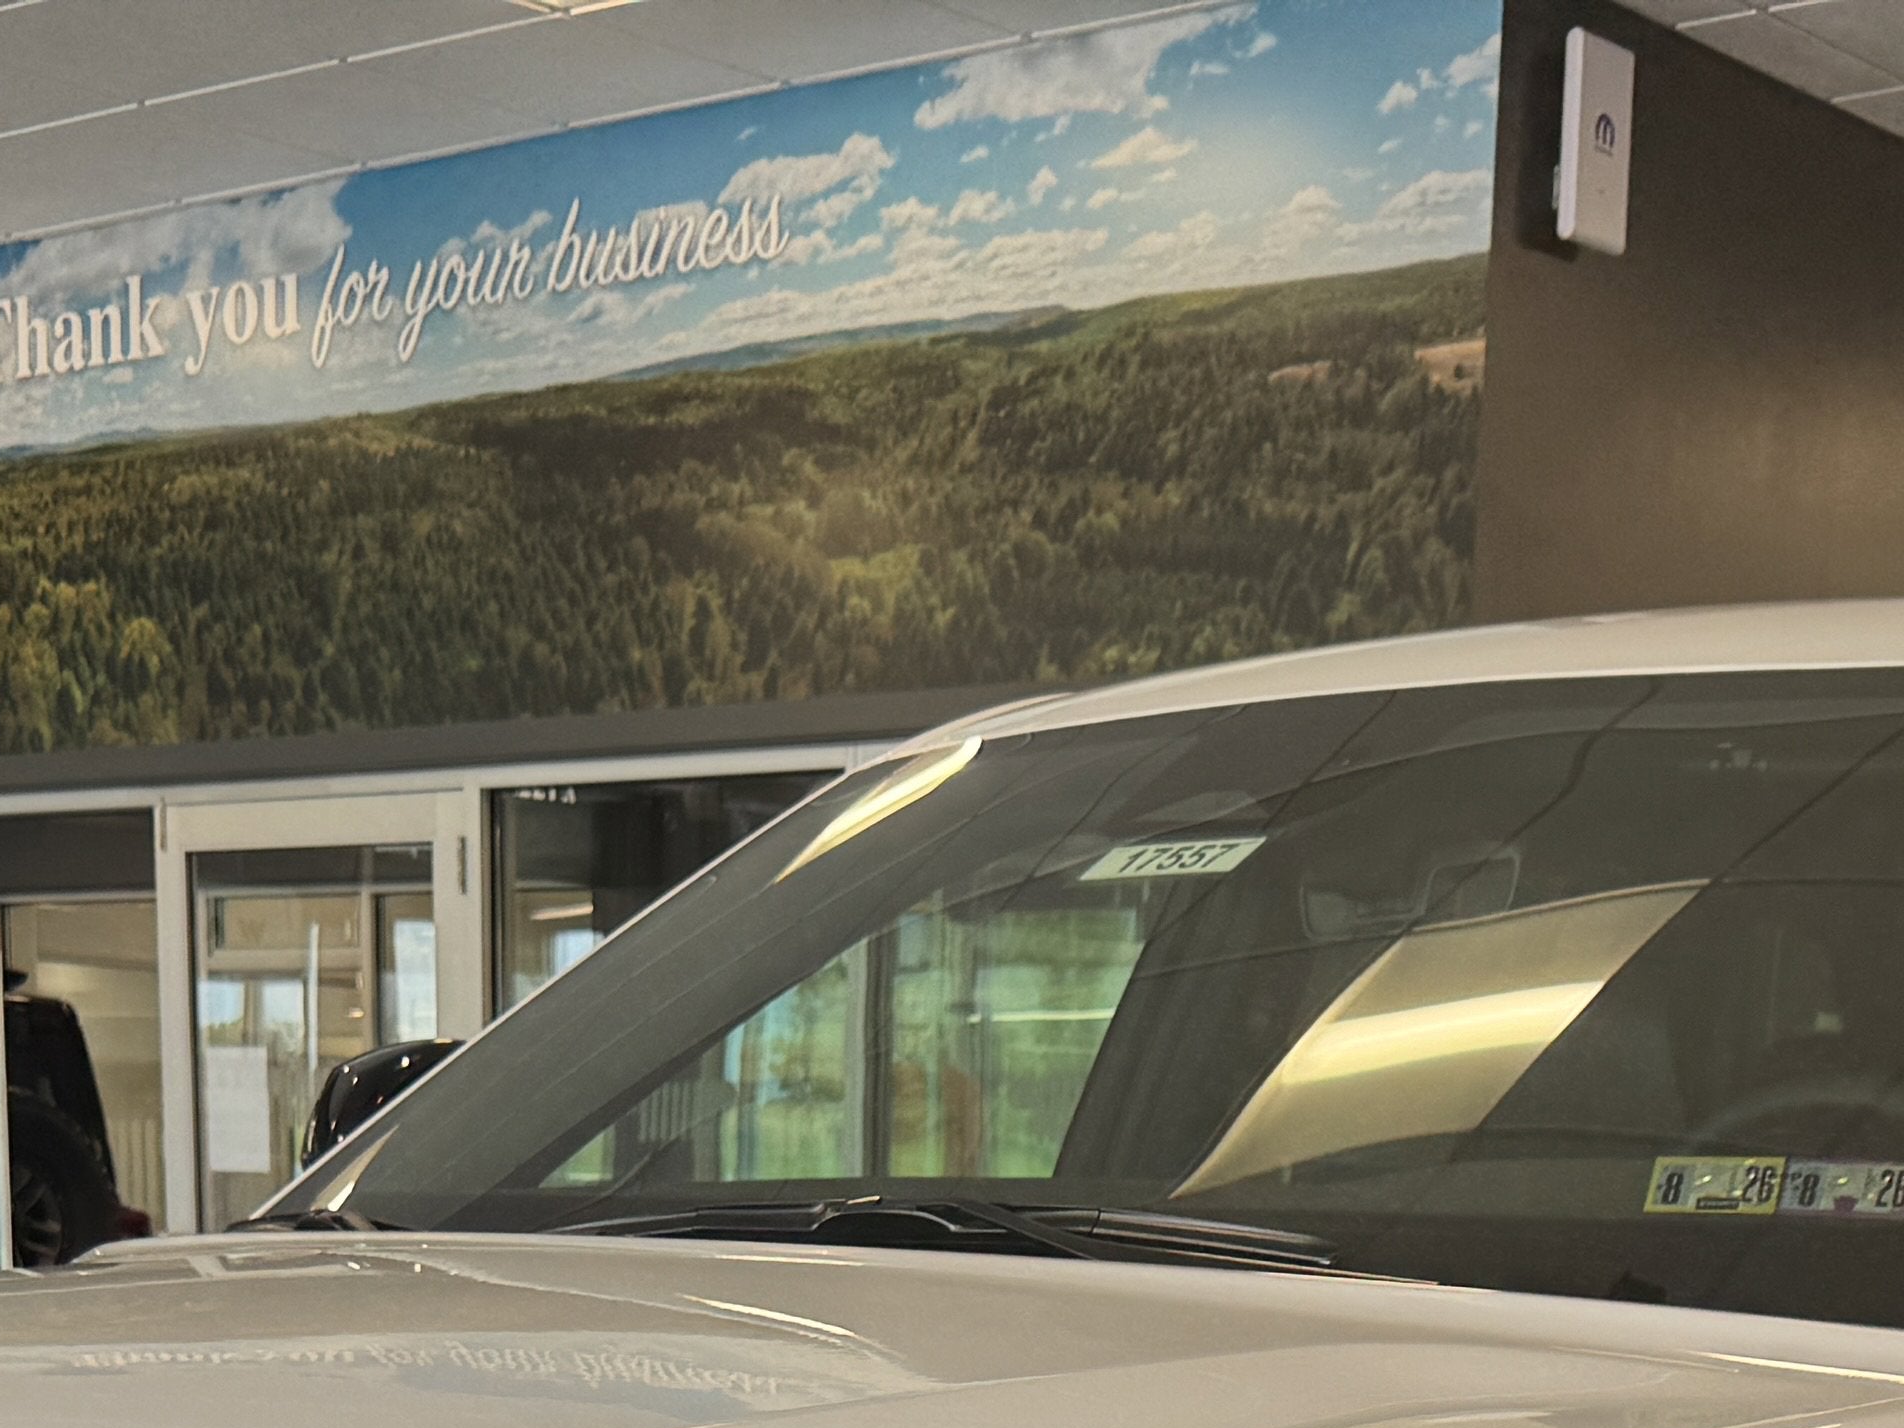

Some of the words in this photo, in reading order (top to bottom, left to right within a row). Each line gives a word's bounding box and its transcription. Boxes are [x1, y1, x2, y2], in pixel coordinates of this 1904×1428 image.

[184, 272, 301, 376] you
[310, 243, 393, 369] for
[398, 238, 535, 362] your
[546, 192, 790, 293] business
[1118, 842, 1241, 873] 17557
[1660, 1172, 1684, 1204] 8
[1743, 1165, 1777, 1204] 26
[1798, 1172, 1820, 1207] 8
